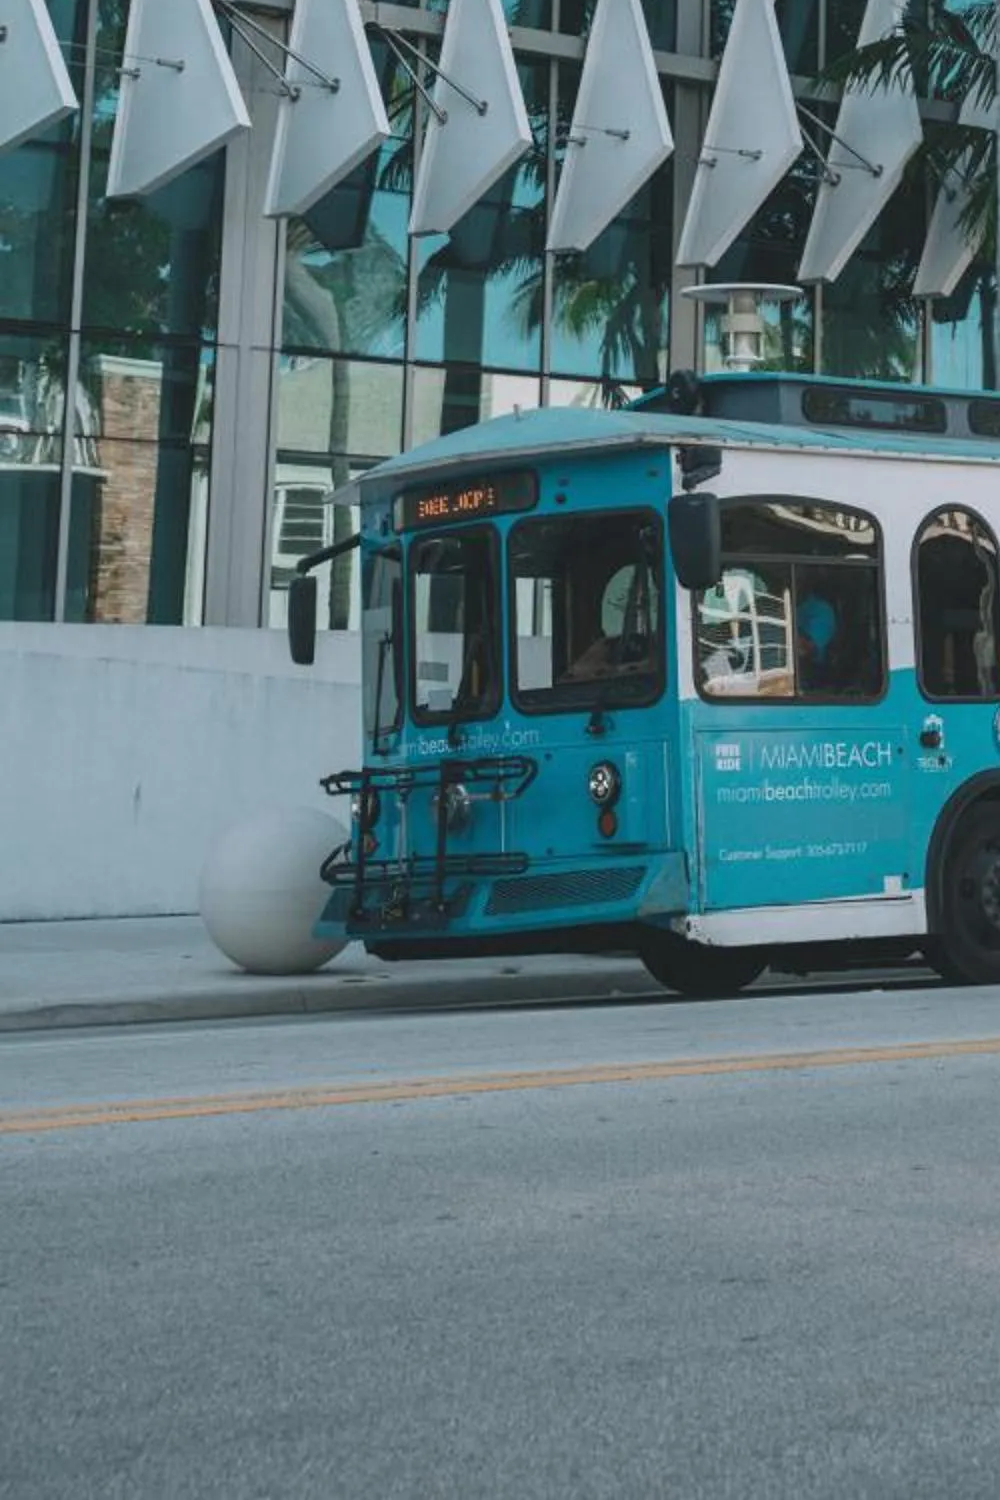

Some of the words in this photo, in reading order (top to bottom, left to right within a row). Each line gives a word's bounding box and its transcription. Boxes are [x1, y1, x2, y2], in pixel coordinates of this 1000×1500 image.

[716, 758, 741, 771] RIDE
[761, 741, 892, 770] MIAMIBEACH
[717, 776, 892, 803] miamibeachtrolley.com
